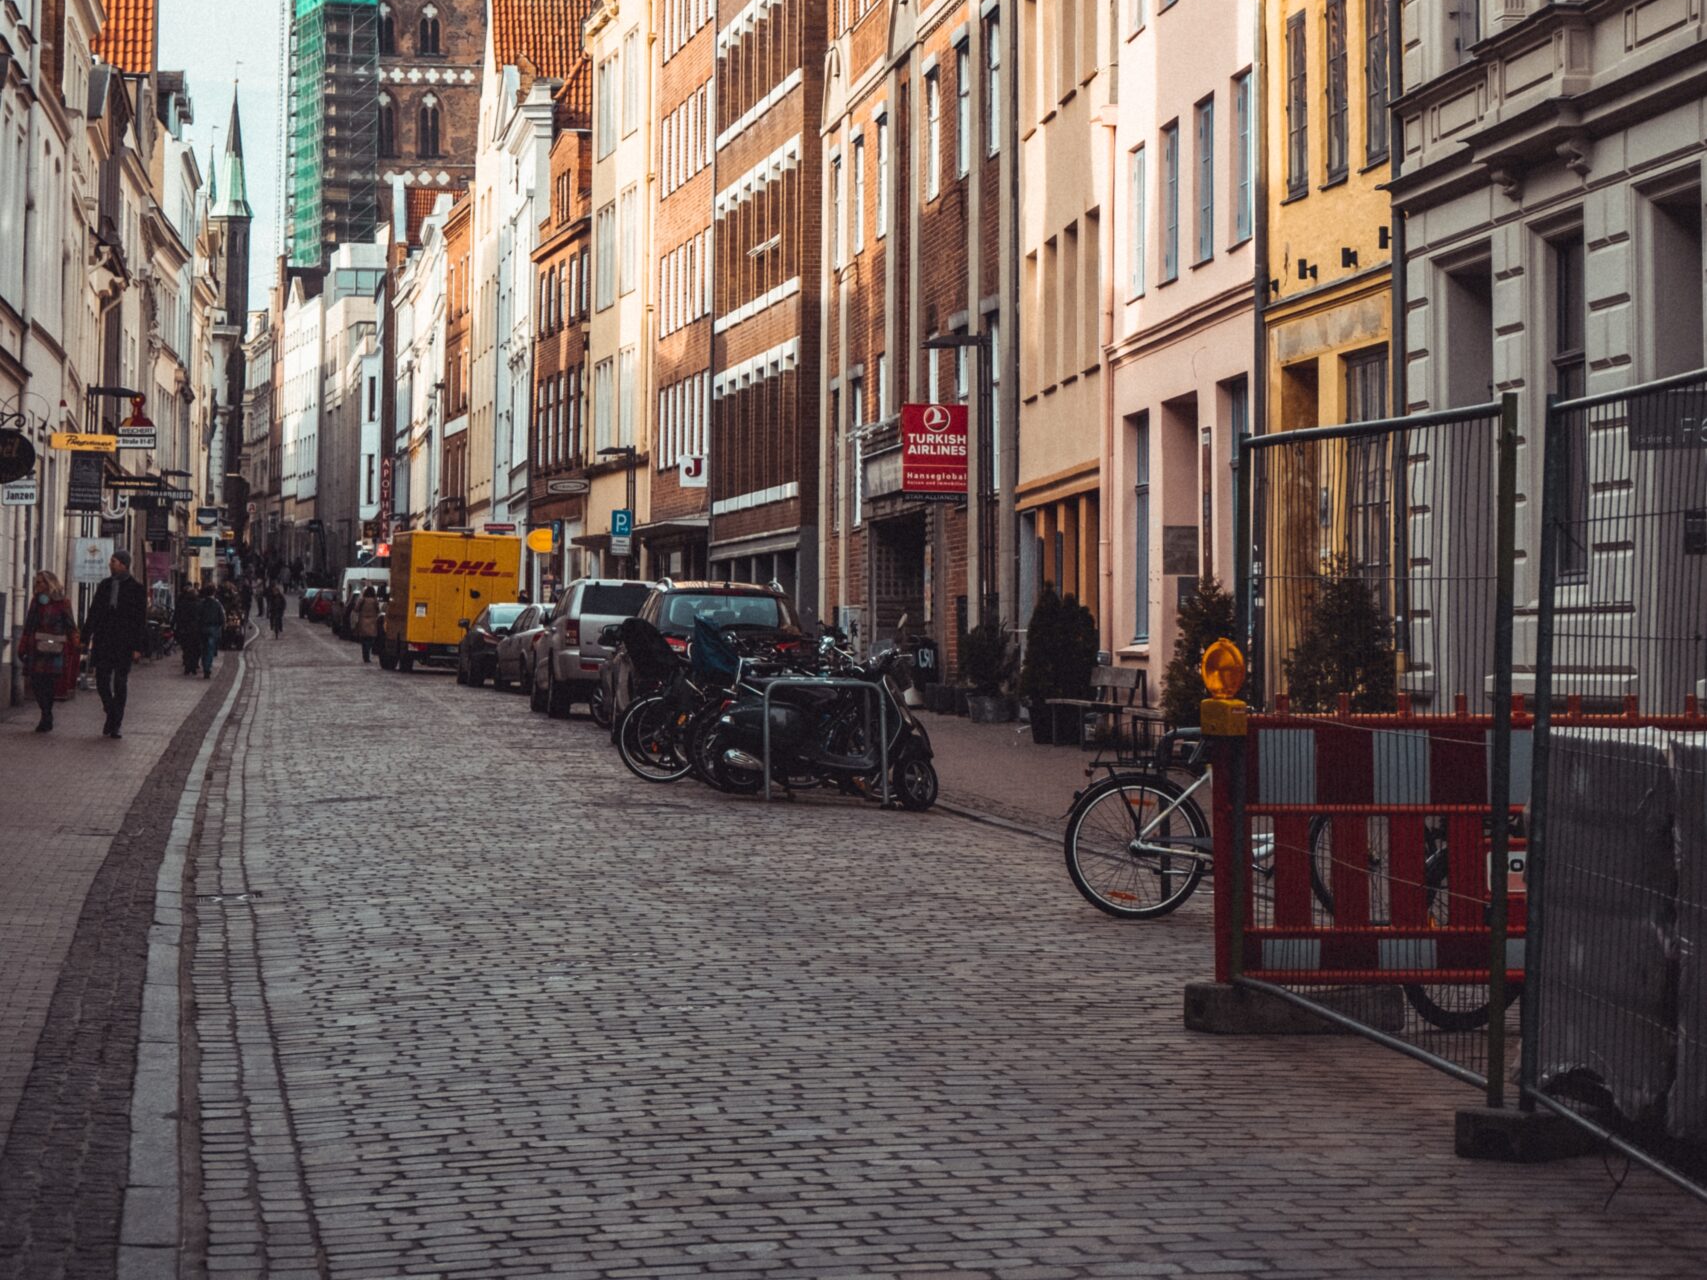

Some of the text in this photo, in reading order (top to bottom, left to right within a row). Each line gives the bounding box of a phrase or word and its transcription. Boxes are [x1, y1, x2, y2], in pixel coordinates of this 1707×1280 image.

[907, 433, 967, 444] TURKISH
[907, 444, 967, 456] AIRLINES
[685, 458, 704, 478] J
[907, 472, 967, 480] Hanseglobal
[6, 491, 35, 500] Janzen
[616, 513, 627, 532] P
[428, 559, 501, 576] DHL
